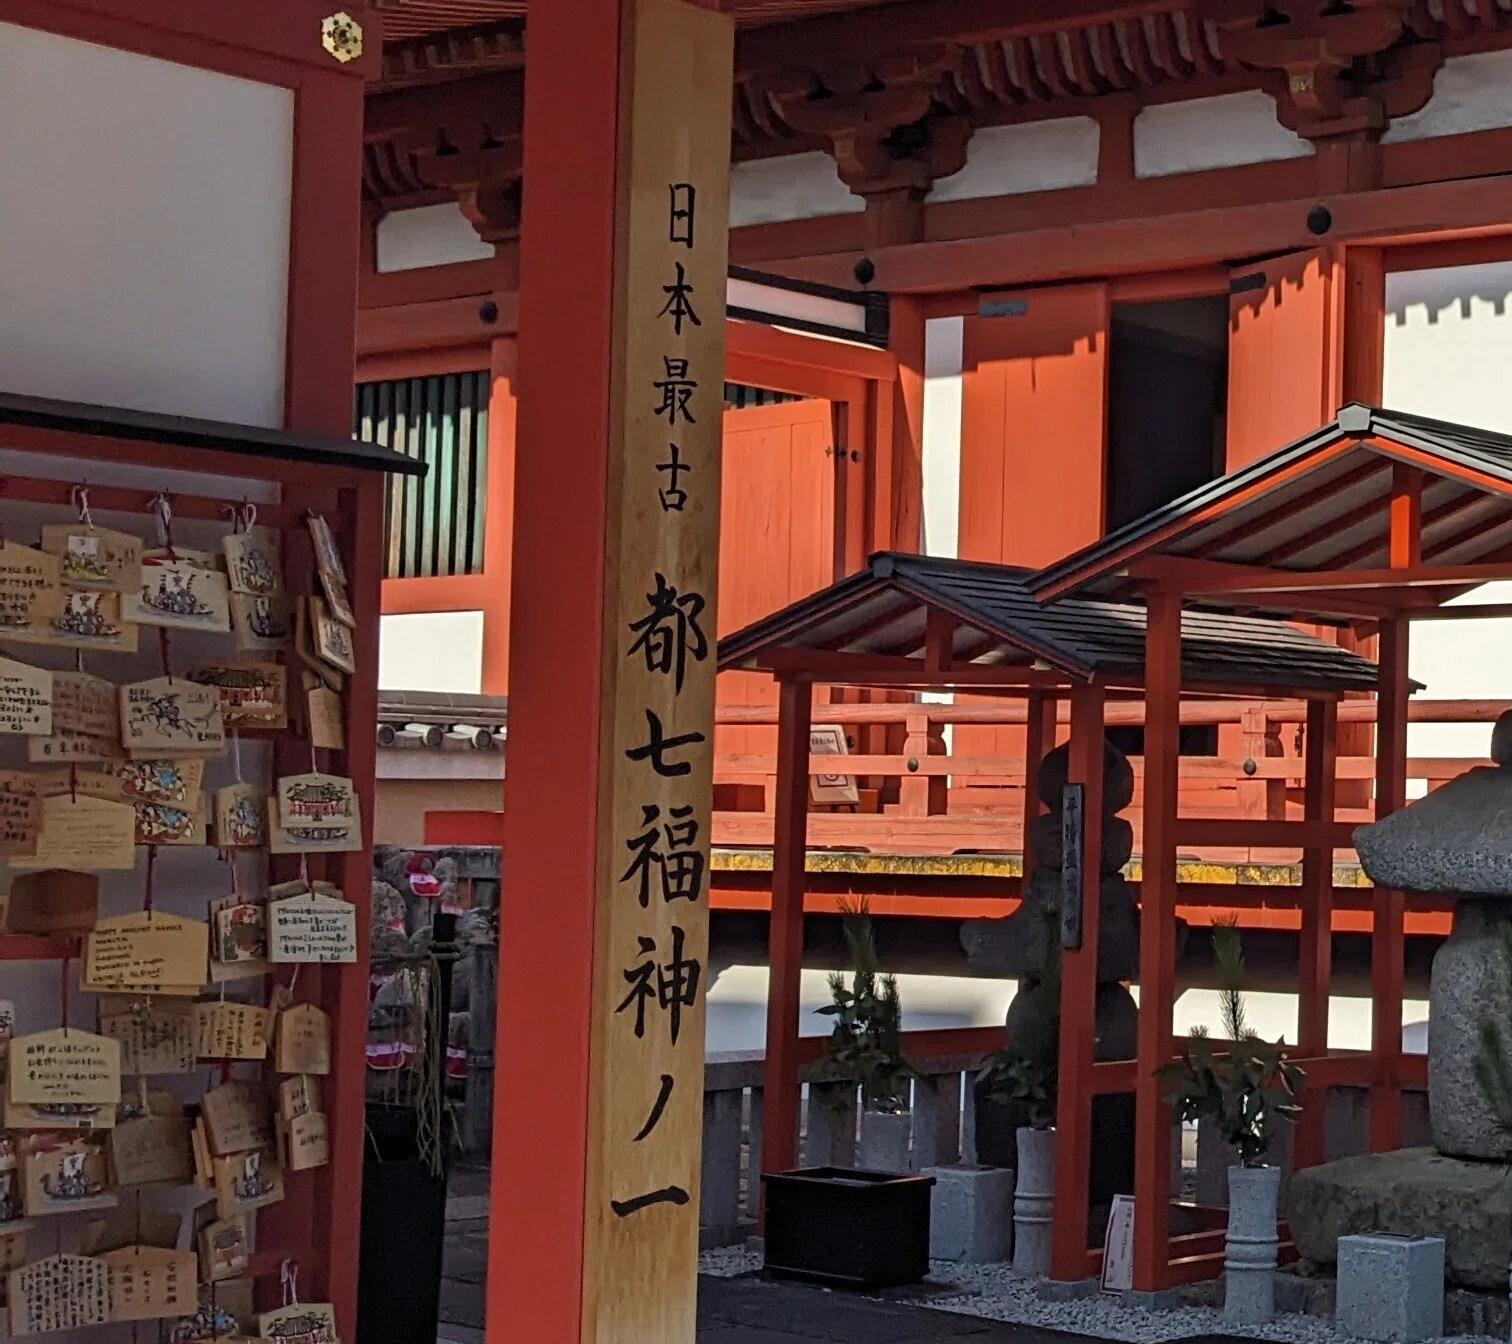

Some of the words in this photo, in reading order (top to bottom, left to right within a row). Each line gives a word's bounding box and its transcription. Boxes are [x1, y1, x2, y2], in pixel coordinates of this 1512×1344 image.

[653, 182, 702, 513] 日本最古
[610, 571, 709, 1217] 都七福神ノ一
